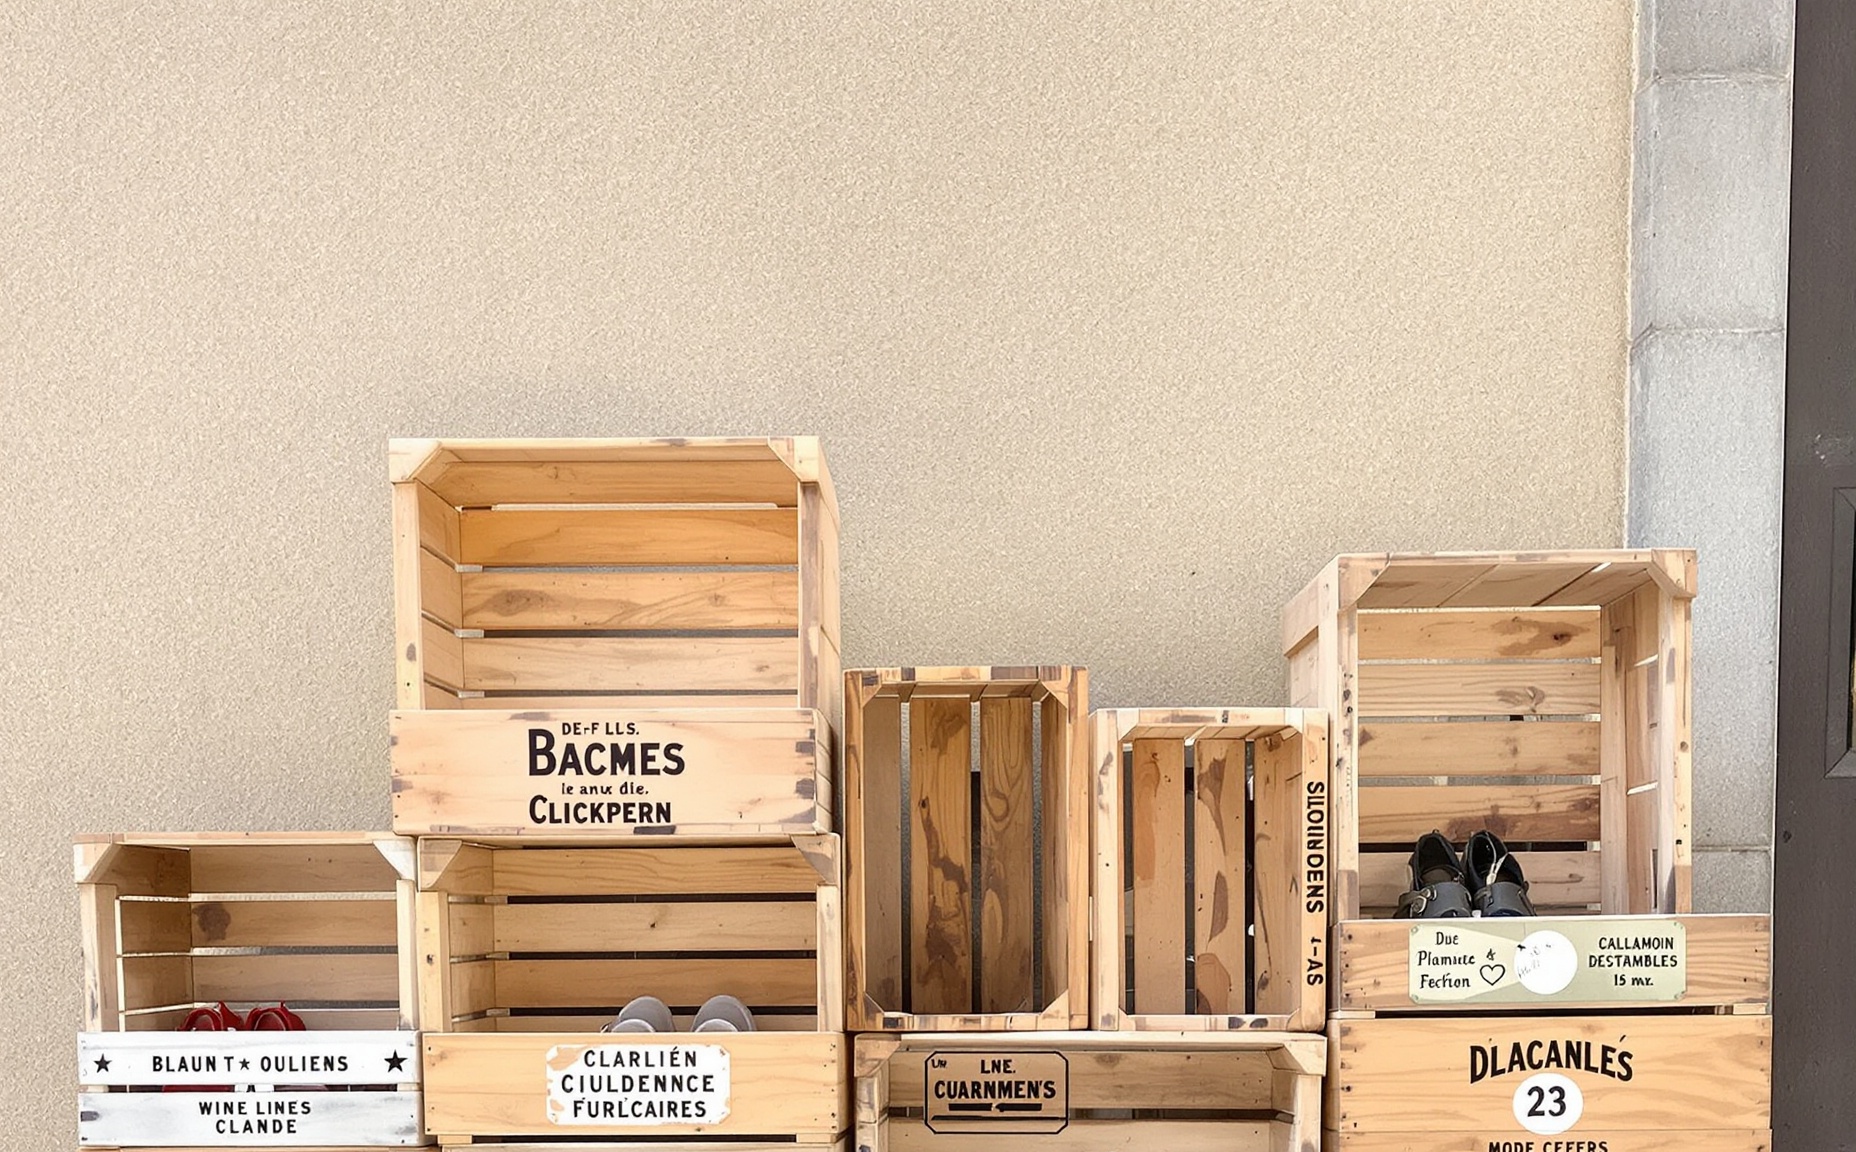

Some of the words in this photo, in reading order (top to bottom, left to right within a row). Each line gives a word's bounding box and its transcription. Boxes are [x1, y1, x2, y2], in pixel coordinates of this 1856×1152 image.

[529, 727, 684, 776] BACMES
[530, 793, 670, 824] CLICKPERN
[1599, 937, 1673, 950] CALLAMOIN
[1589, 955, 1677, 967] DESTAMBLES
[261, 1056, 347, 1072] OULIENS
[584, 1047, 696, 1067] CLARLIÉN
[199, 1102, 247, 1115] WINE
[257, 1102, 310, 1114] LINES
[1528, 1086, 1566, 1117] 23
[216, 1120, 296, 1134] CLANDE
